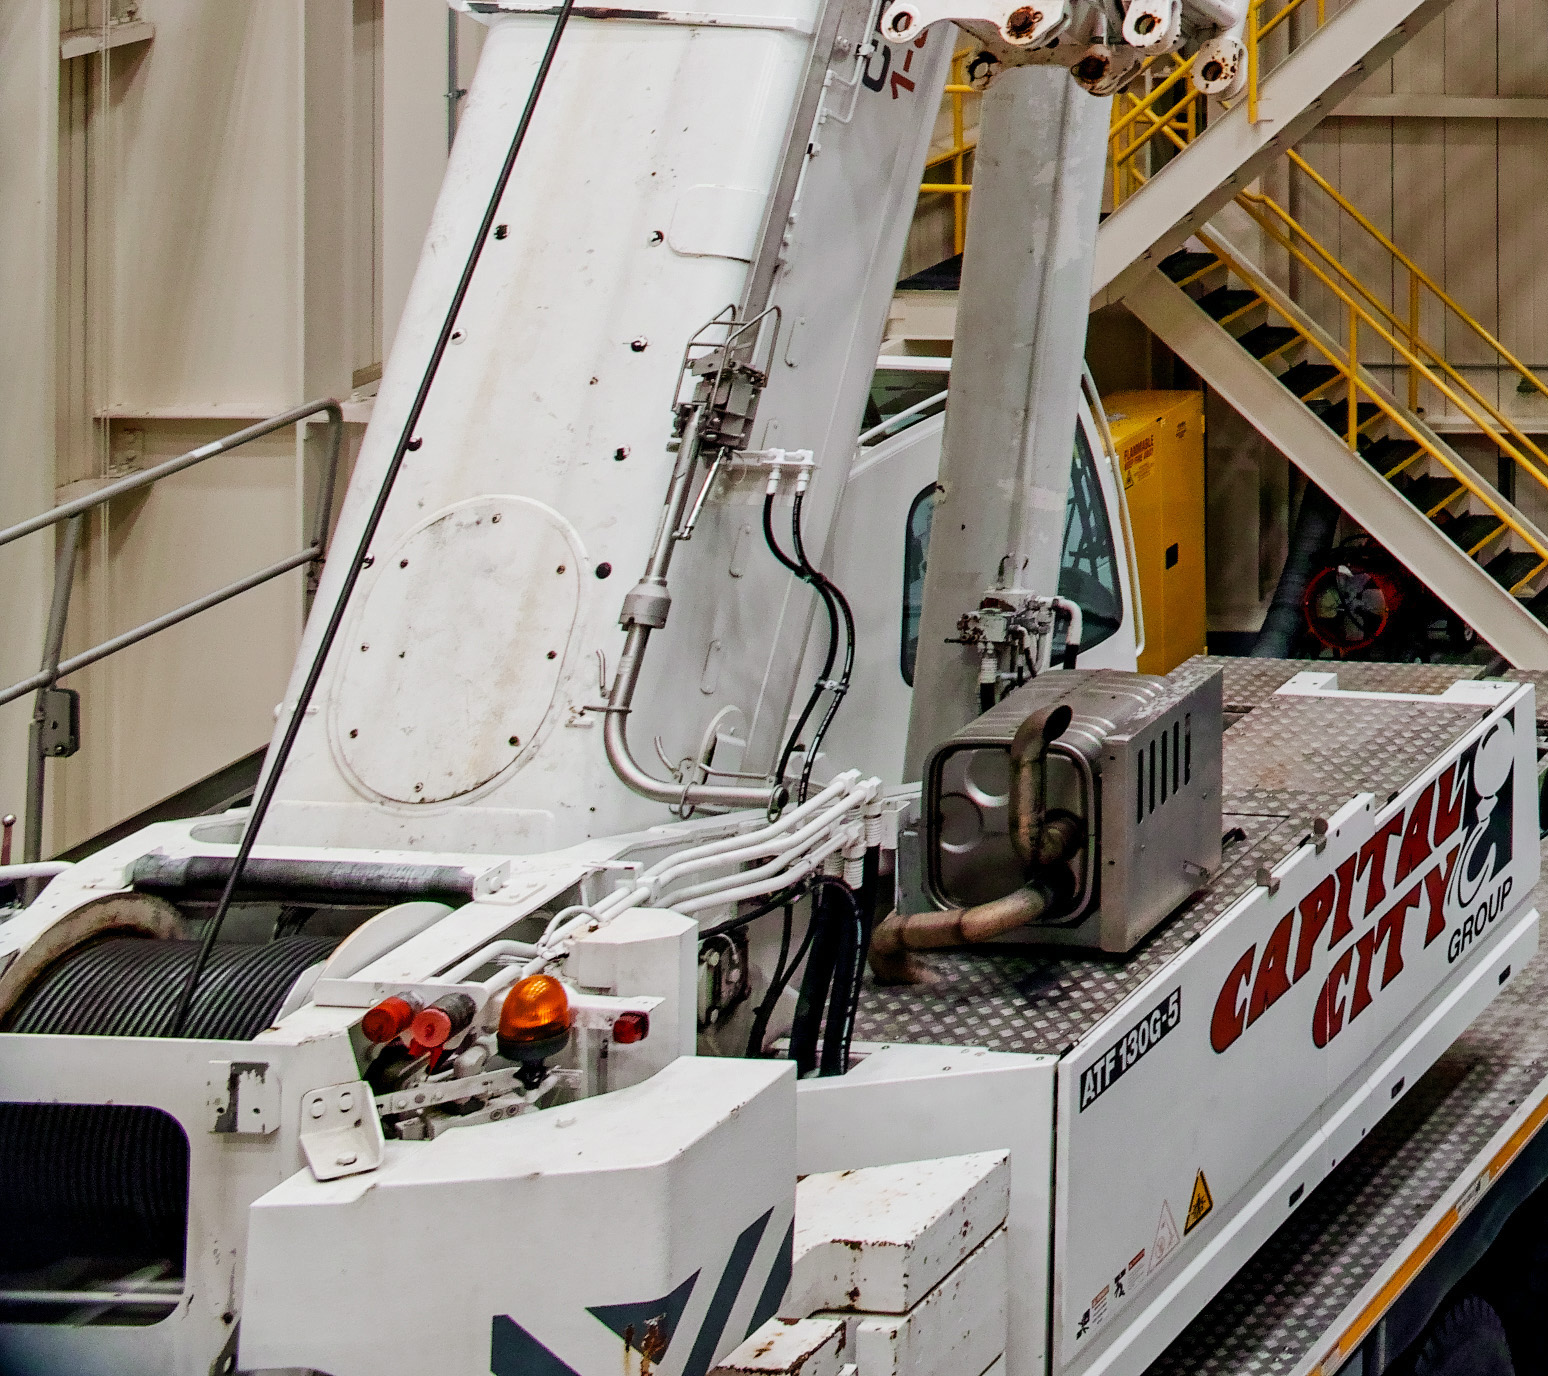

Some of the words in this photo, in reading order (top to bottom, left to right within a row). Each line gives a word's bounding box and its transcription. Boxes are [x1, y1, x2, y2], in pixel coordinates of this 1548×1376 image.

[1209, 758, 1466, 1054] CAPITAL
[1311, 844, 1461, 1049] CITY
[1447, 875, 1513, 965] GROUP
[1081, 1055, 1118, 1107] ATF
[1118, 997, 1180, 1076] 130G-5
